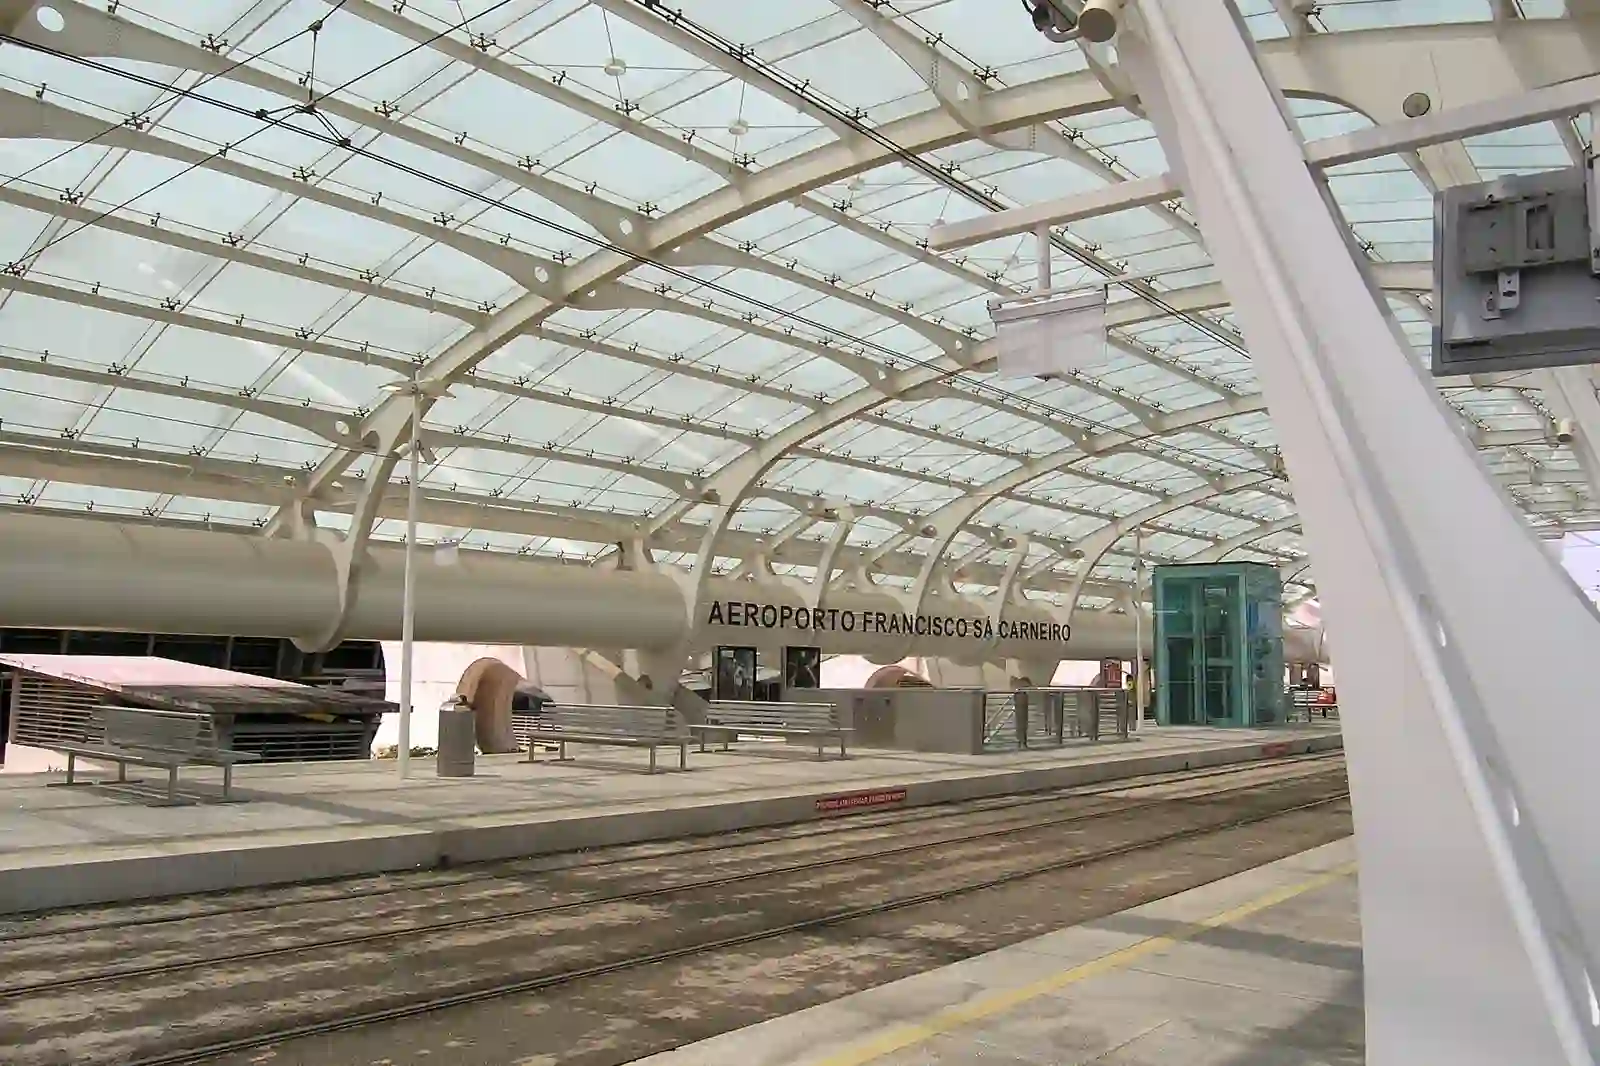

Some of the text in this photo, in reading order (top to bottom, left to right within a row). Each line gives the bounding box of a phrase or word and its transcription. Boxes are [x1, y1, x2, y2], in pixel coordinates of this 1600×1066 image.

[708, 600, 1071, 641] AEROPORTO FRANCISCO SÁ CARNEIRO
